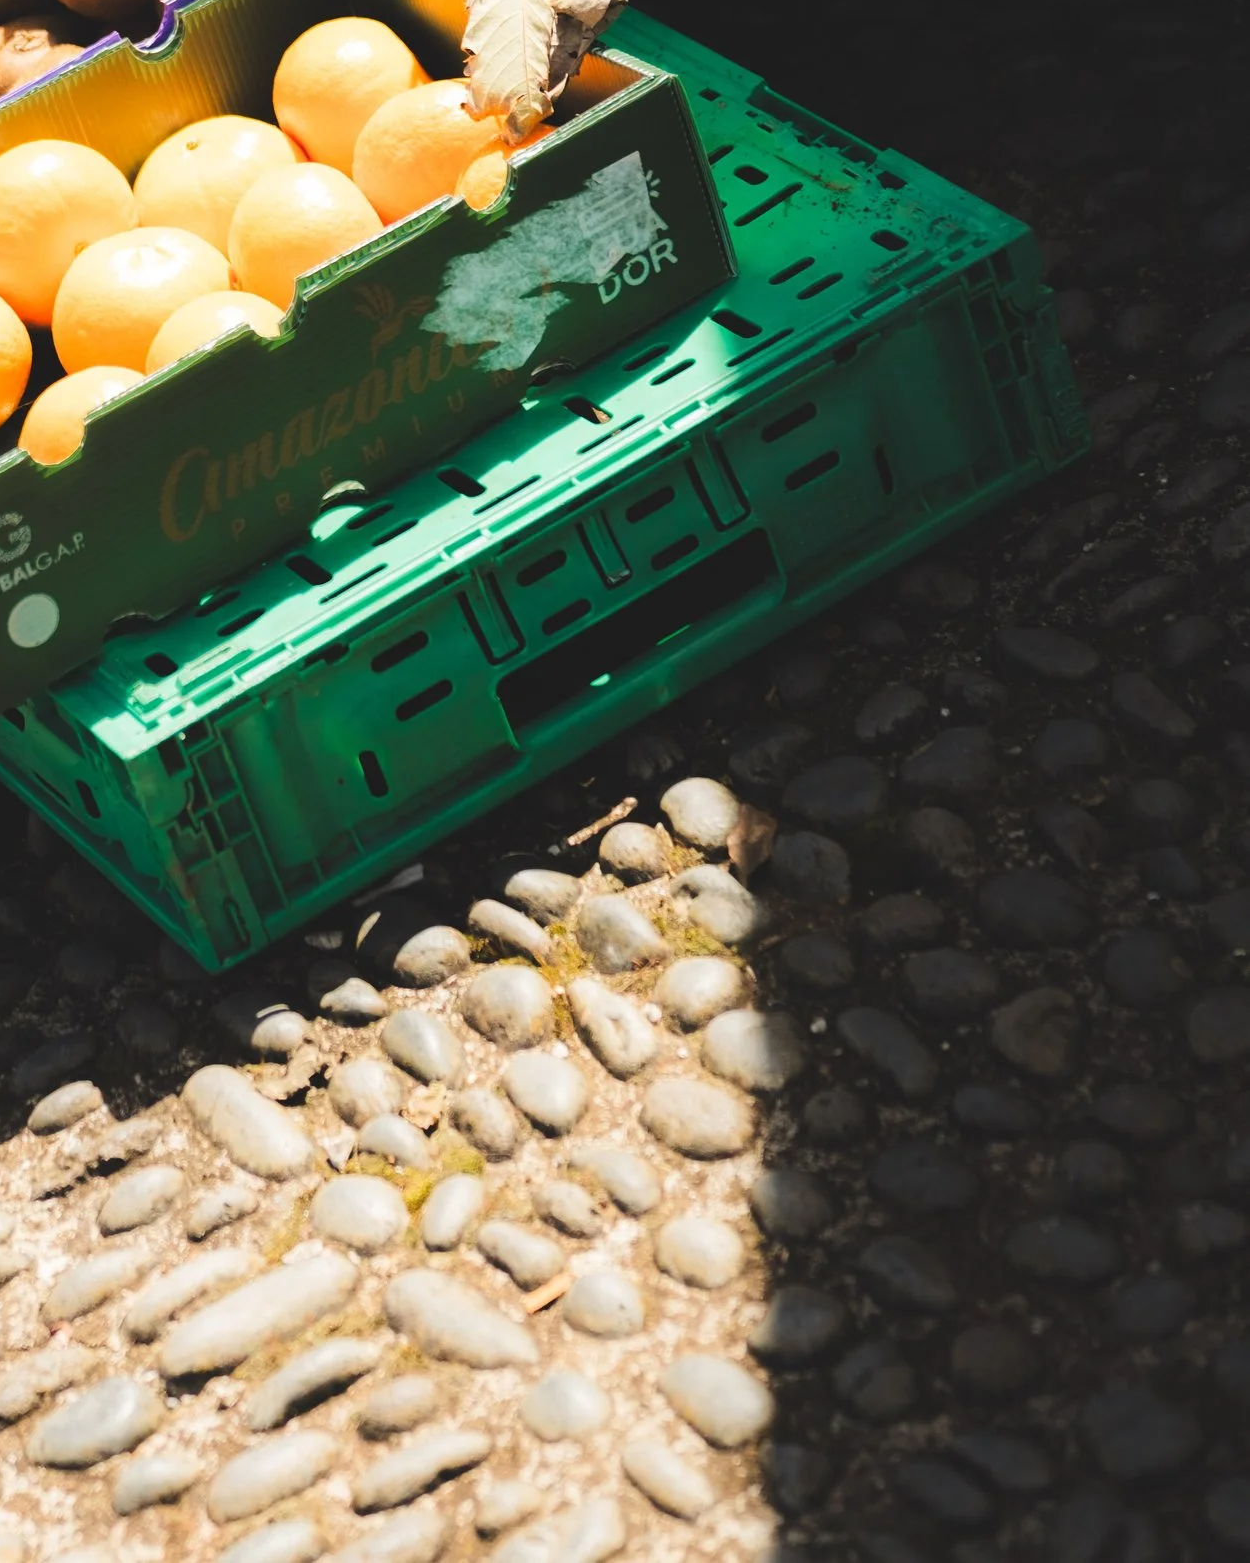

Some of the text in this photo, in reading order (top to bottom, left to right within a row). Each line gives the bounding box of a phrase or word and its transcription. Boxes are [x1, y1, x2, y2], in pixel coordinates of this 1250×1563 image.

[598, 237, 679, 305] DOR
[160, 332, 502, 544] Amazoni
[232, 368, 516, 542] PREMIUM
